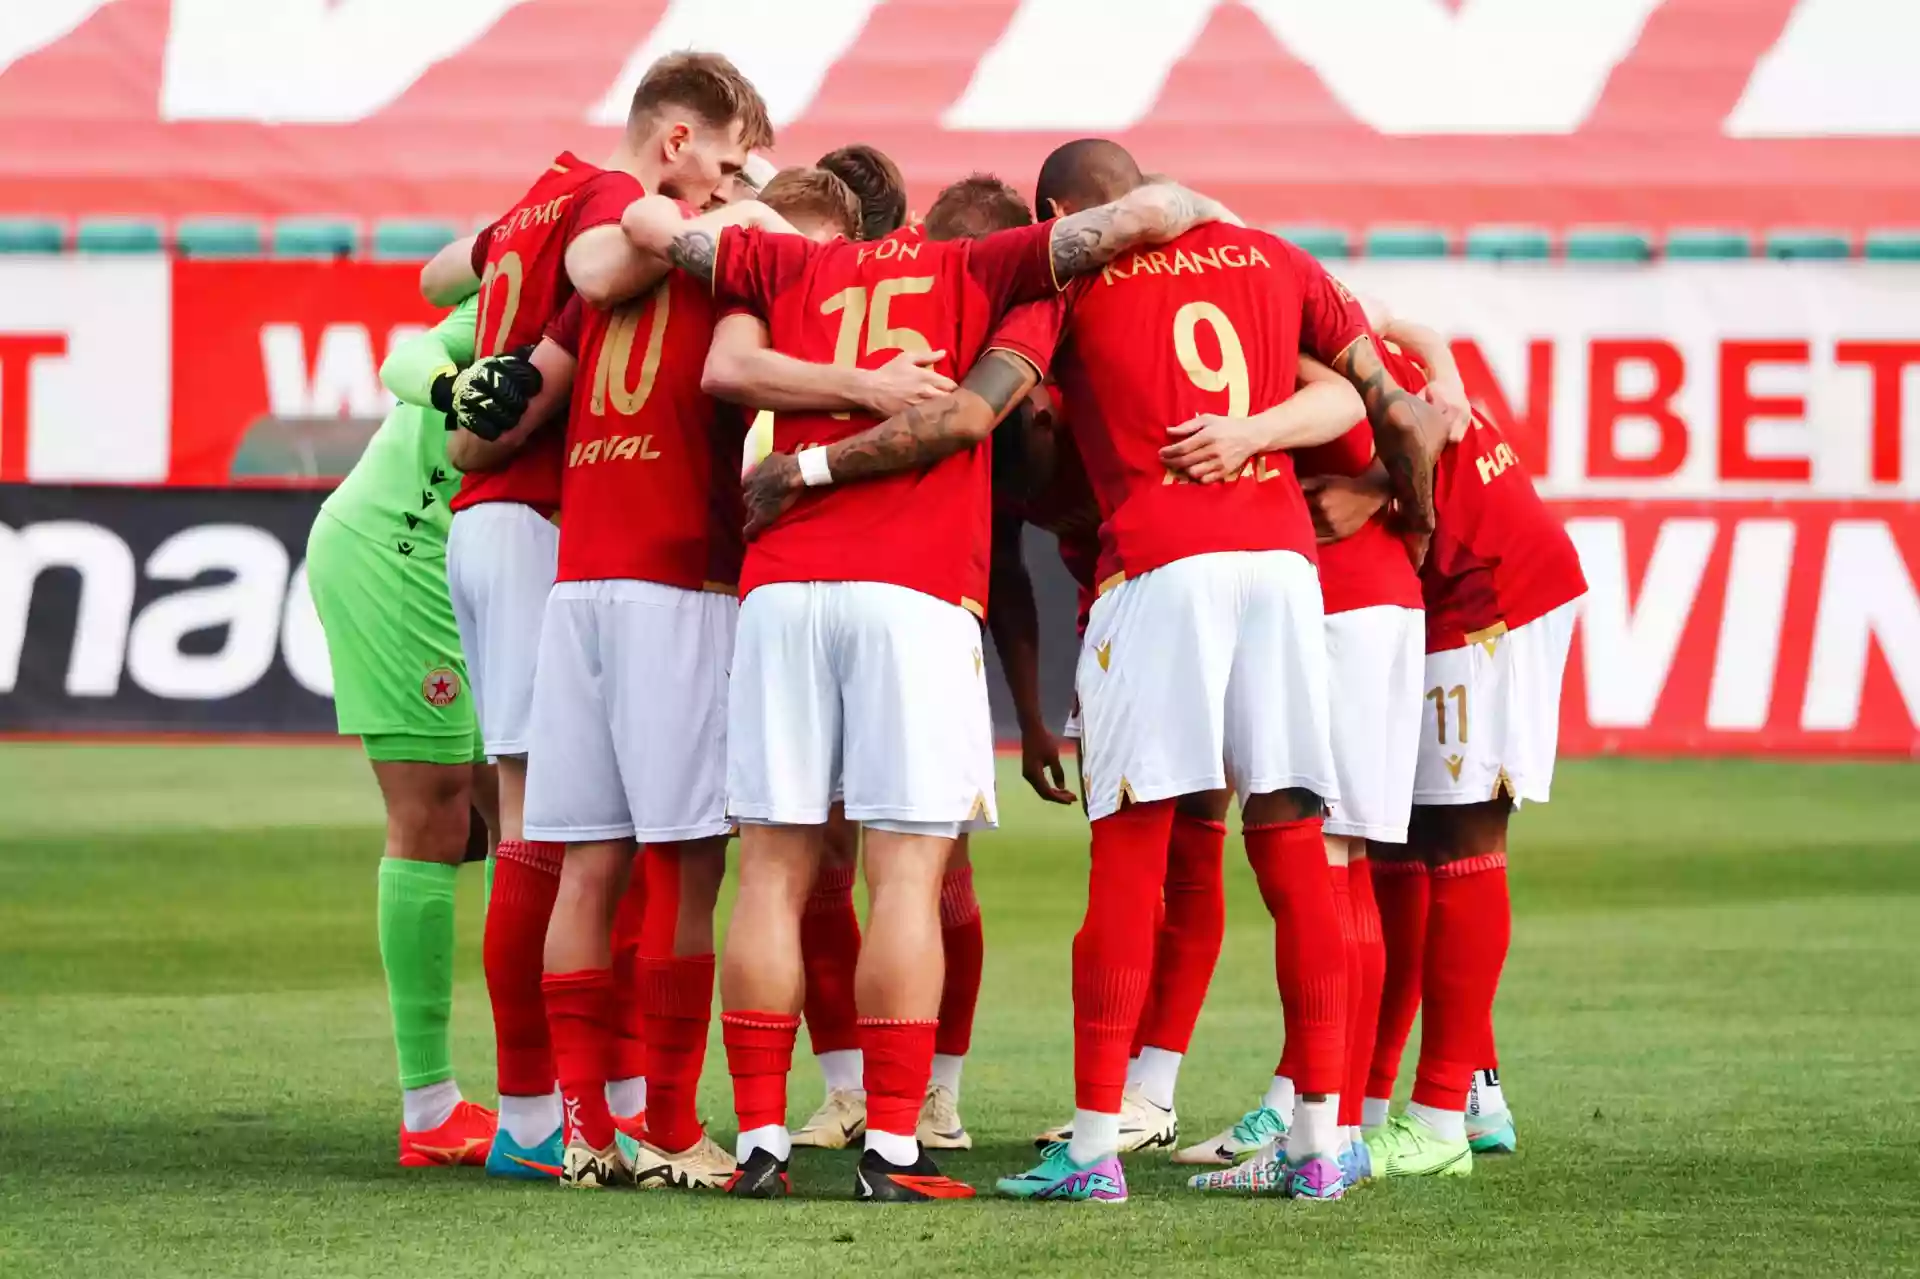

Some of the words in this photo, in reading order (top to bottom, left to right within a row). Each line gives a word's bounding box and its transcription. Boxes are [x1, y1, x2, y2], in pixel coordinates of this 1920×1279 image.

[1102, 245, 1271, 286] KARANGA
[820, 275, 936, 419] 15
[1173, 301, 1250, 418] 9
[1426, 684, 1468, 745] 11
